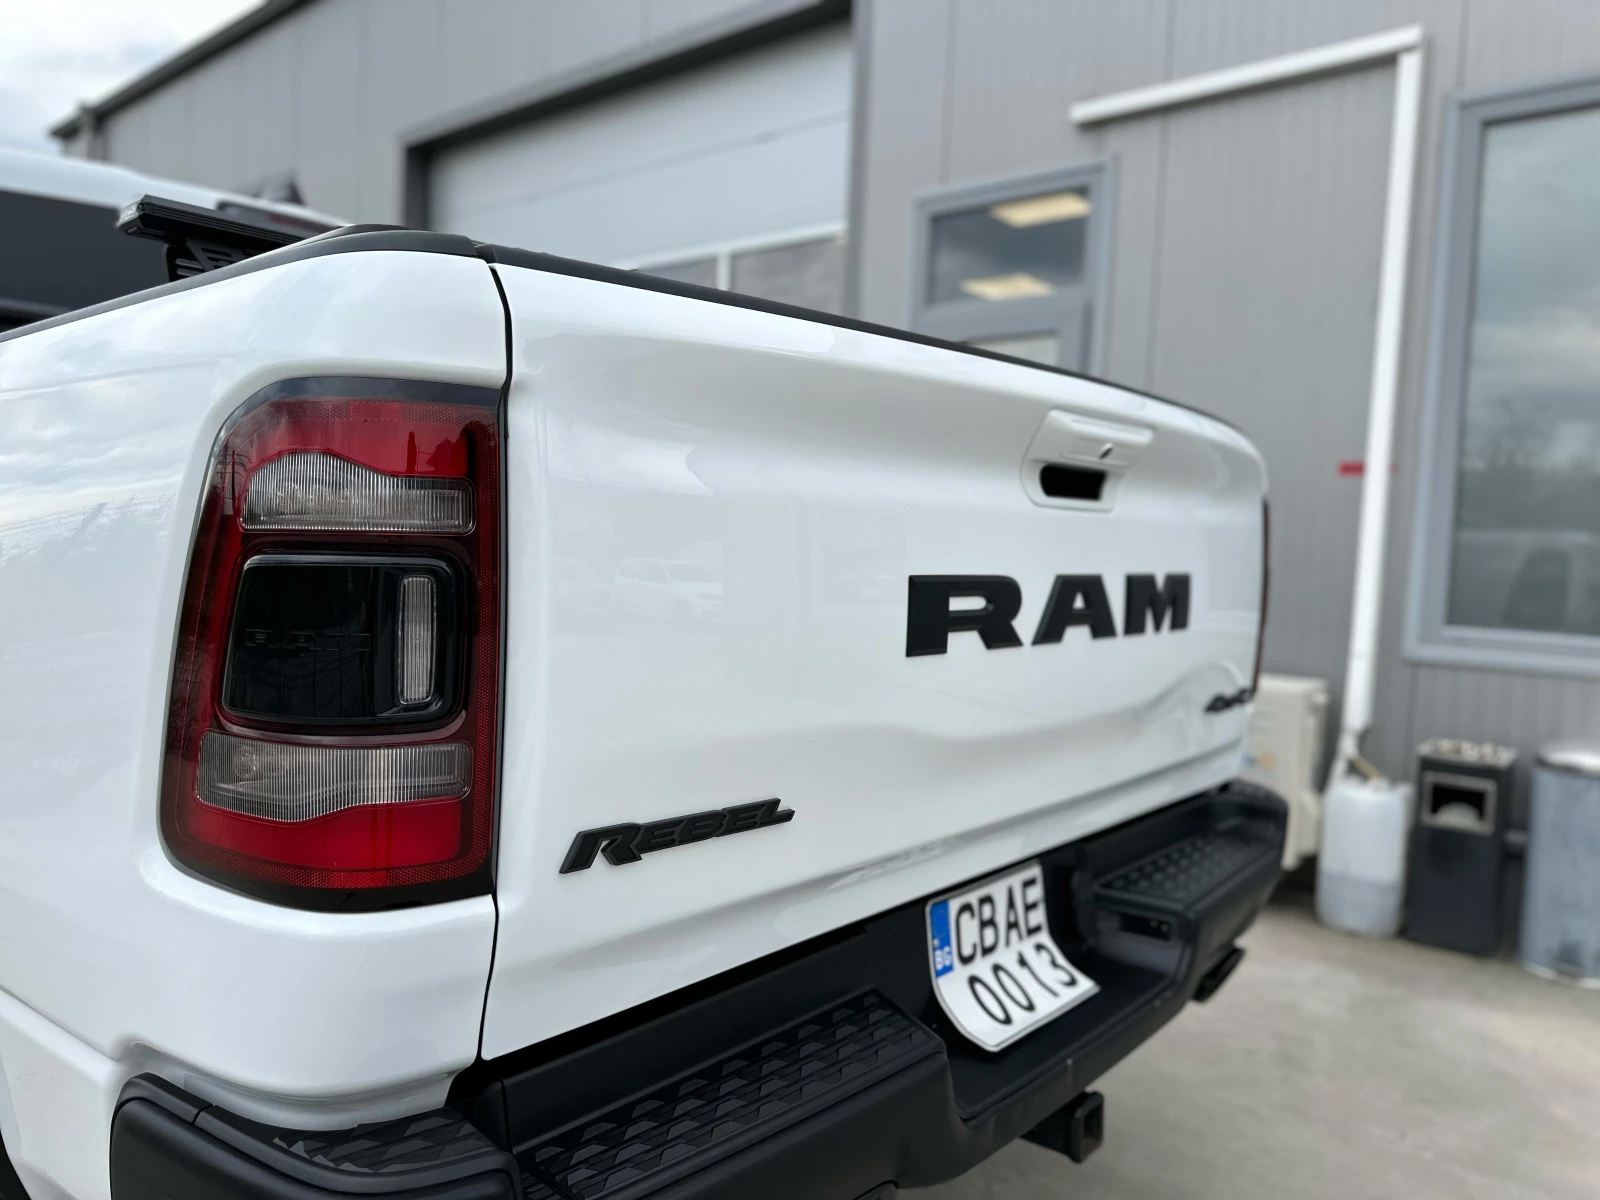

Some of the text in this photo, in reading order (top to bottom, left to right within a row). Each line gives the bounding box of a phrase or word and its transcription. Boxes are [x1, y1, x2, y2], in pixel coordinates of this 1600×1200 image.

[245, 629, 370, 651] RAM
[905, 573, 1190, 657] RAM
[559, 798, 795, 874] REBEL
[968, 942, 1078, 1025] 0013
